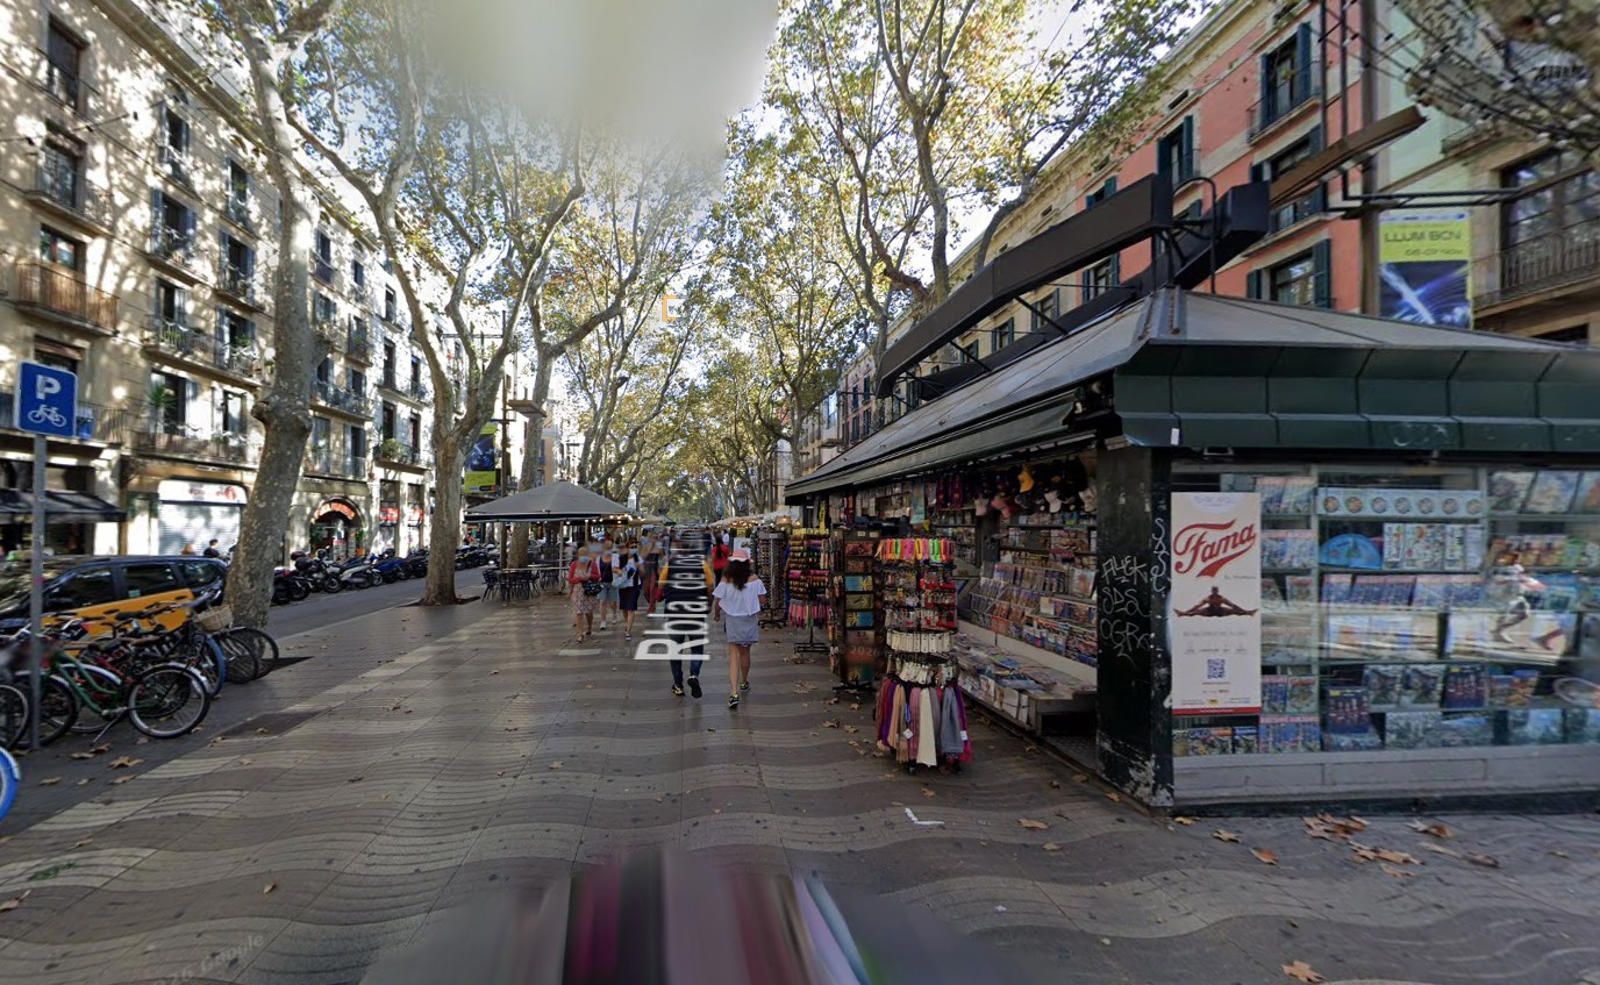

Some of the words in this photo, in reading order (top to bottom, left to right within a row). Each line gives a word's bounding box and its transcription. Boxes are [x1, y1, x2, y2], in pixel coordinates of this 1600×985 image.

[1384, 231, 1426, 243] LLUM
[1428, 229, 1462, 241] BCN
[36, 374, 61, 400] P
[1173, 519, 1257, 578] Fama
